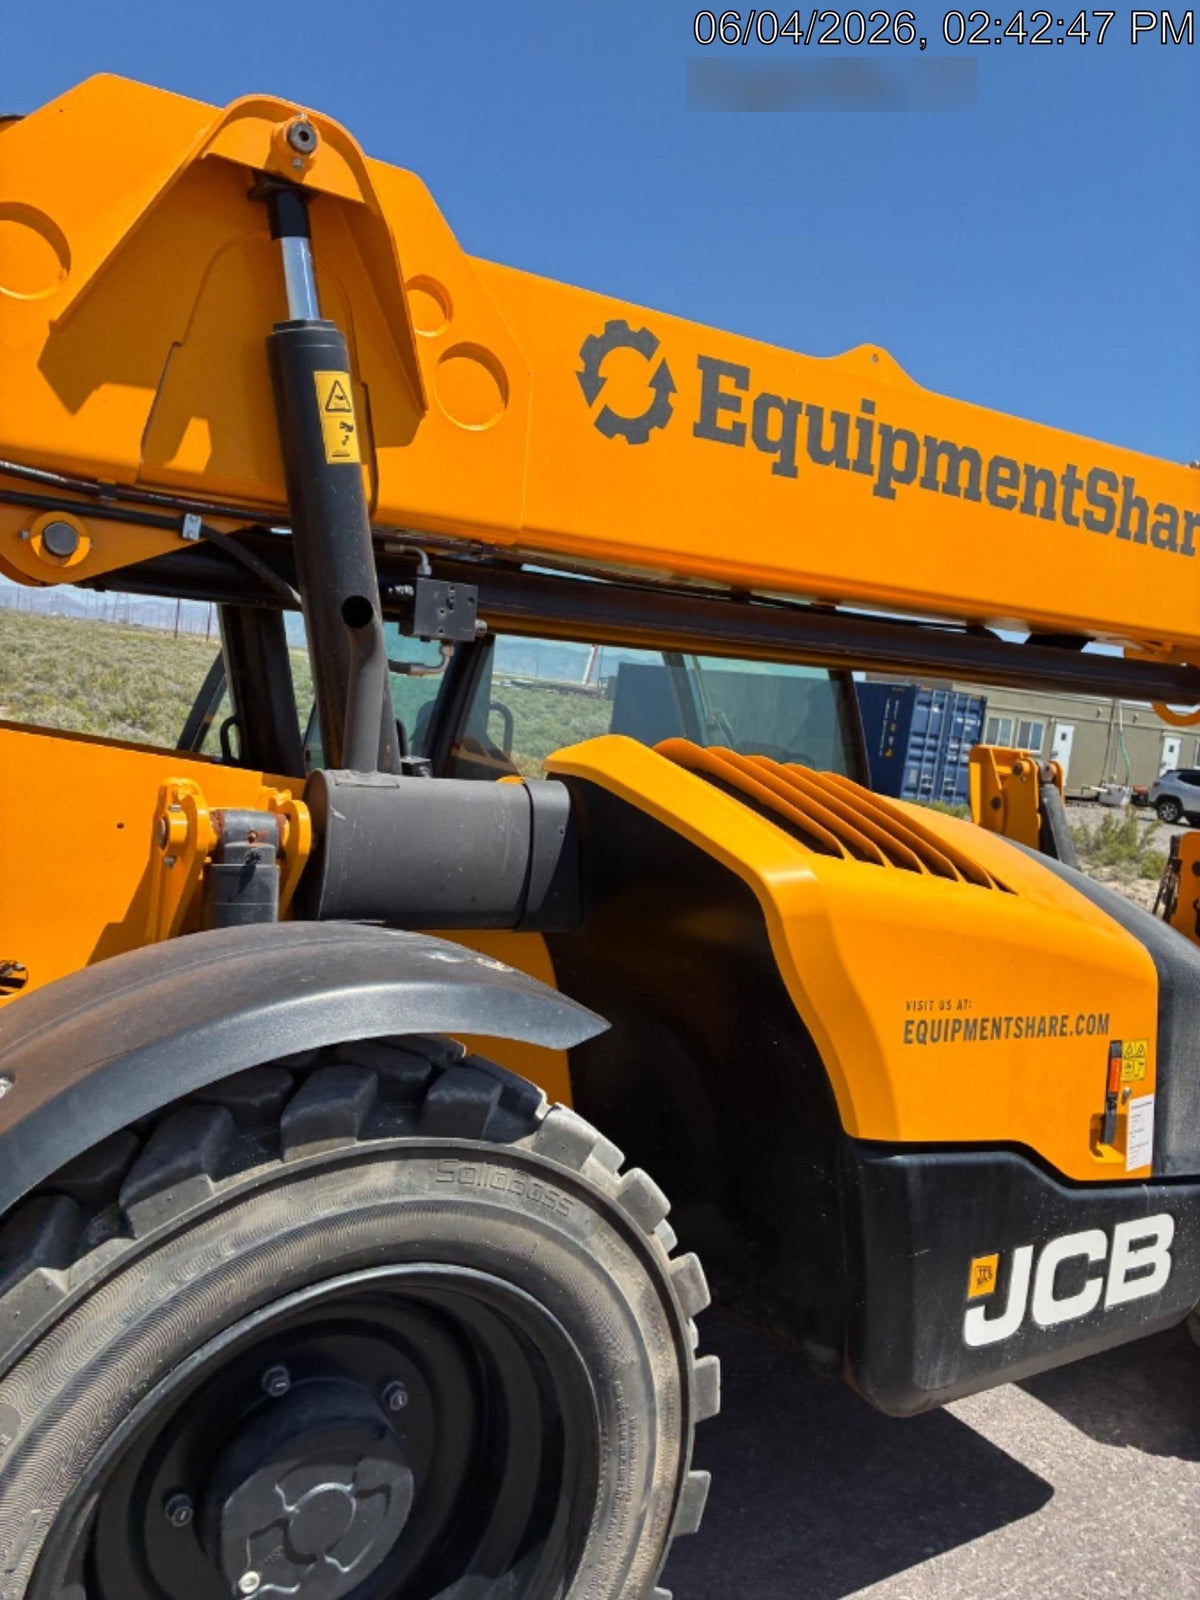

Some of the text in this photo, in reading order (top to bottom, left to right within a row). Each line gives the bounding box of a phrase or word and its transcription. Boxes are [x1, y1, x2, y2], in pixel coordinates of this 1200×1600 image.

[906, 999, 973, 1012] VISIT US AT:
[903, 1013, 1111, 1045] EQUIPMENTSHARE.COM
[963, 1213, 1175, 1347] JCB
